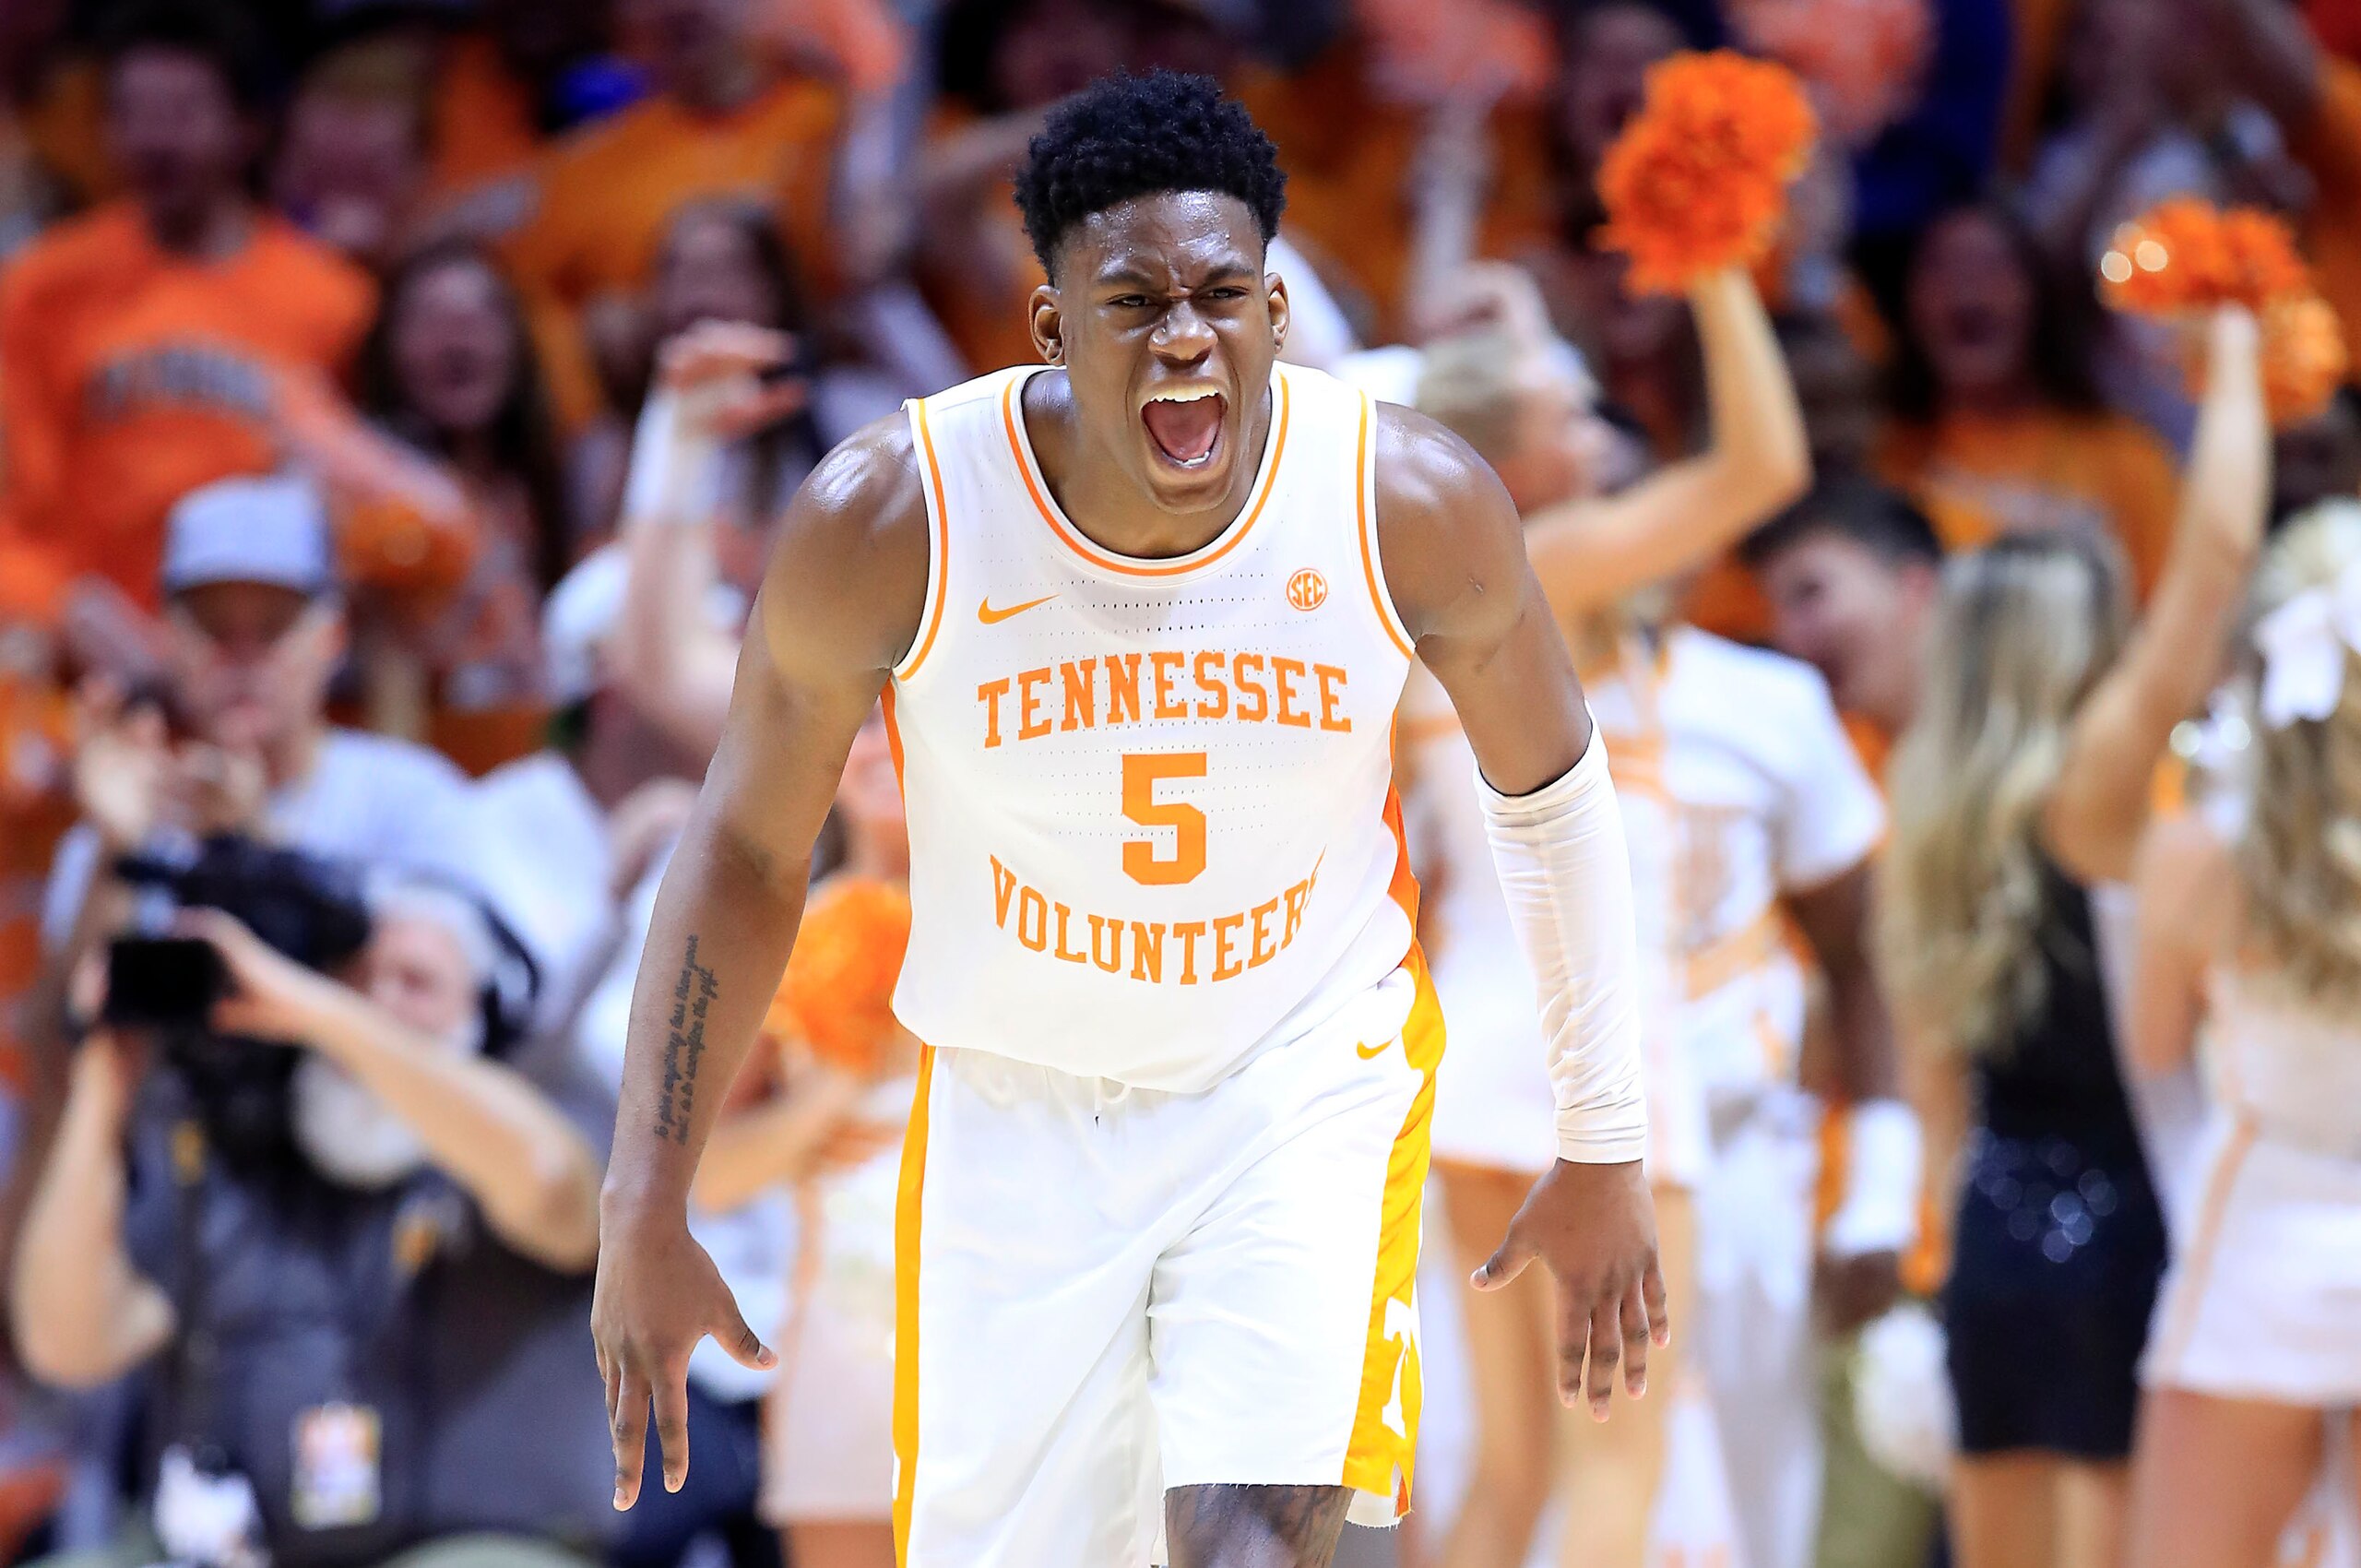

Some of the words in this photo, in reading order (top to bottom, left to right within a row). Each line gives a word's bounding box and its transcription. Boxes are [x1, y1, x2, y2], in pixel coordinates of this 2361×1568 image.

[1291, 573, 1323, 607] SEC
[977, 649, 1353, 749] TENNESSEE
[1121, 752, 1207, 886] 5
[990, 843, 1327, 985] VOLUNTEER
